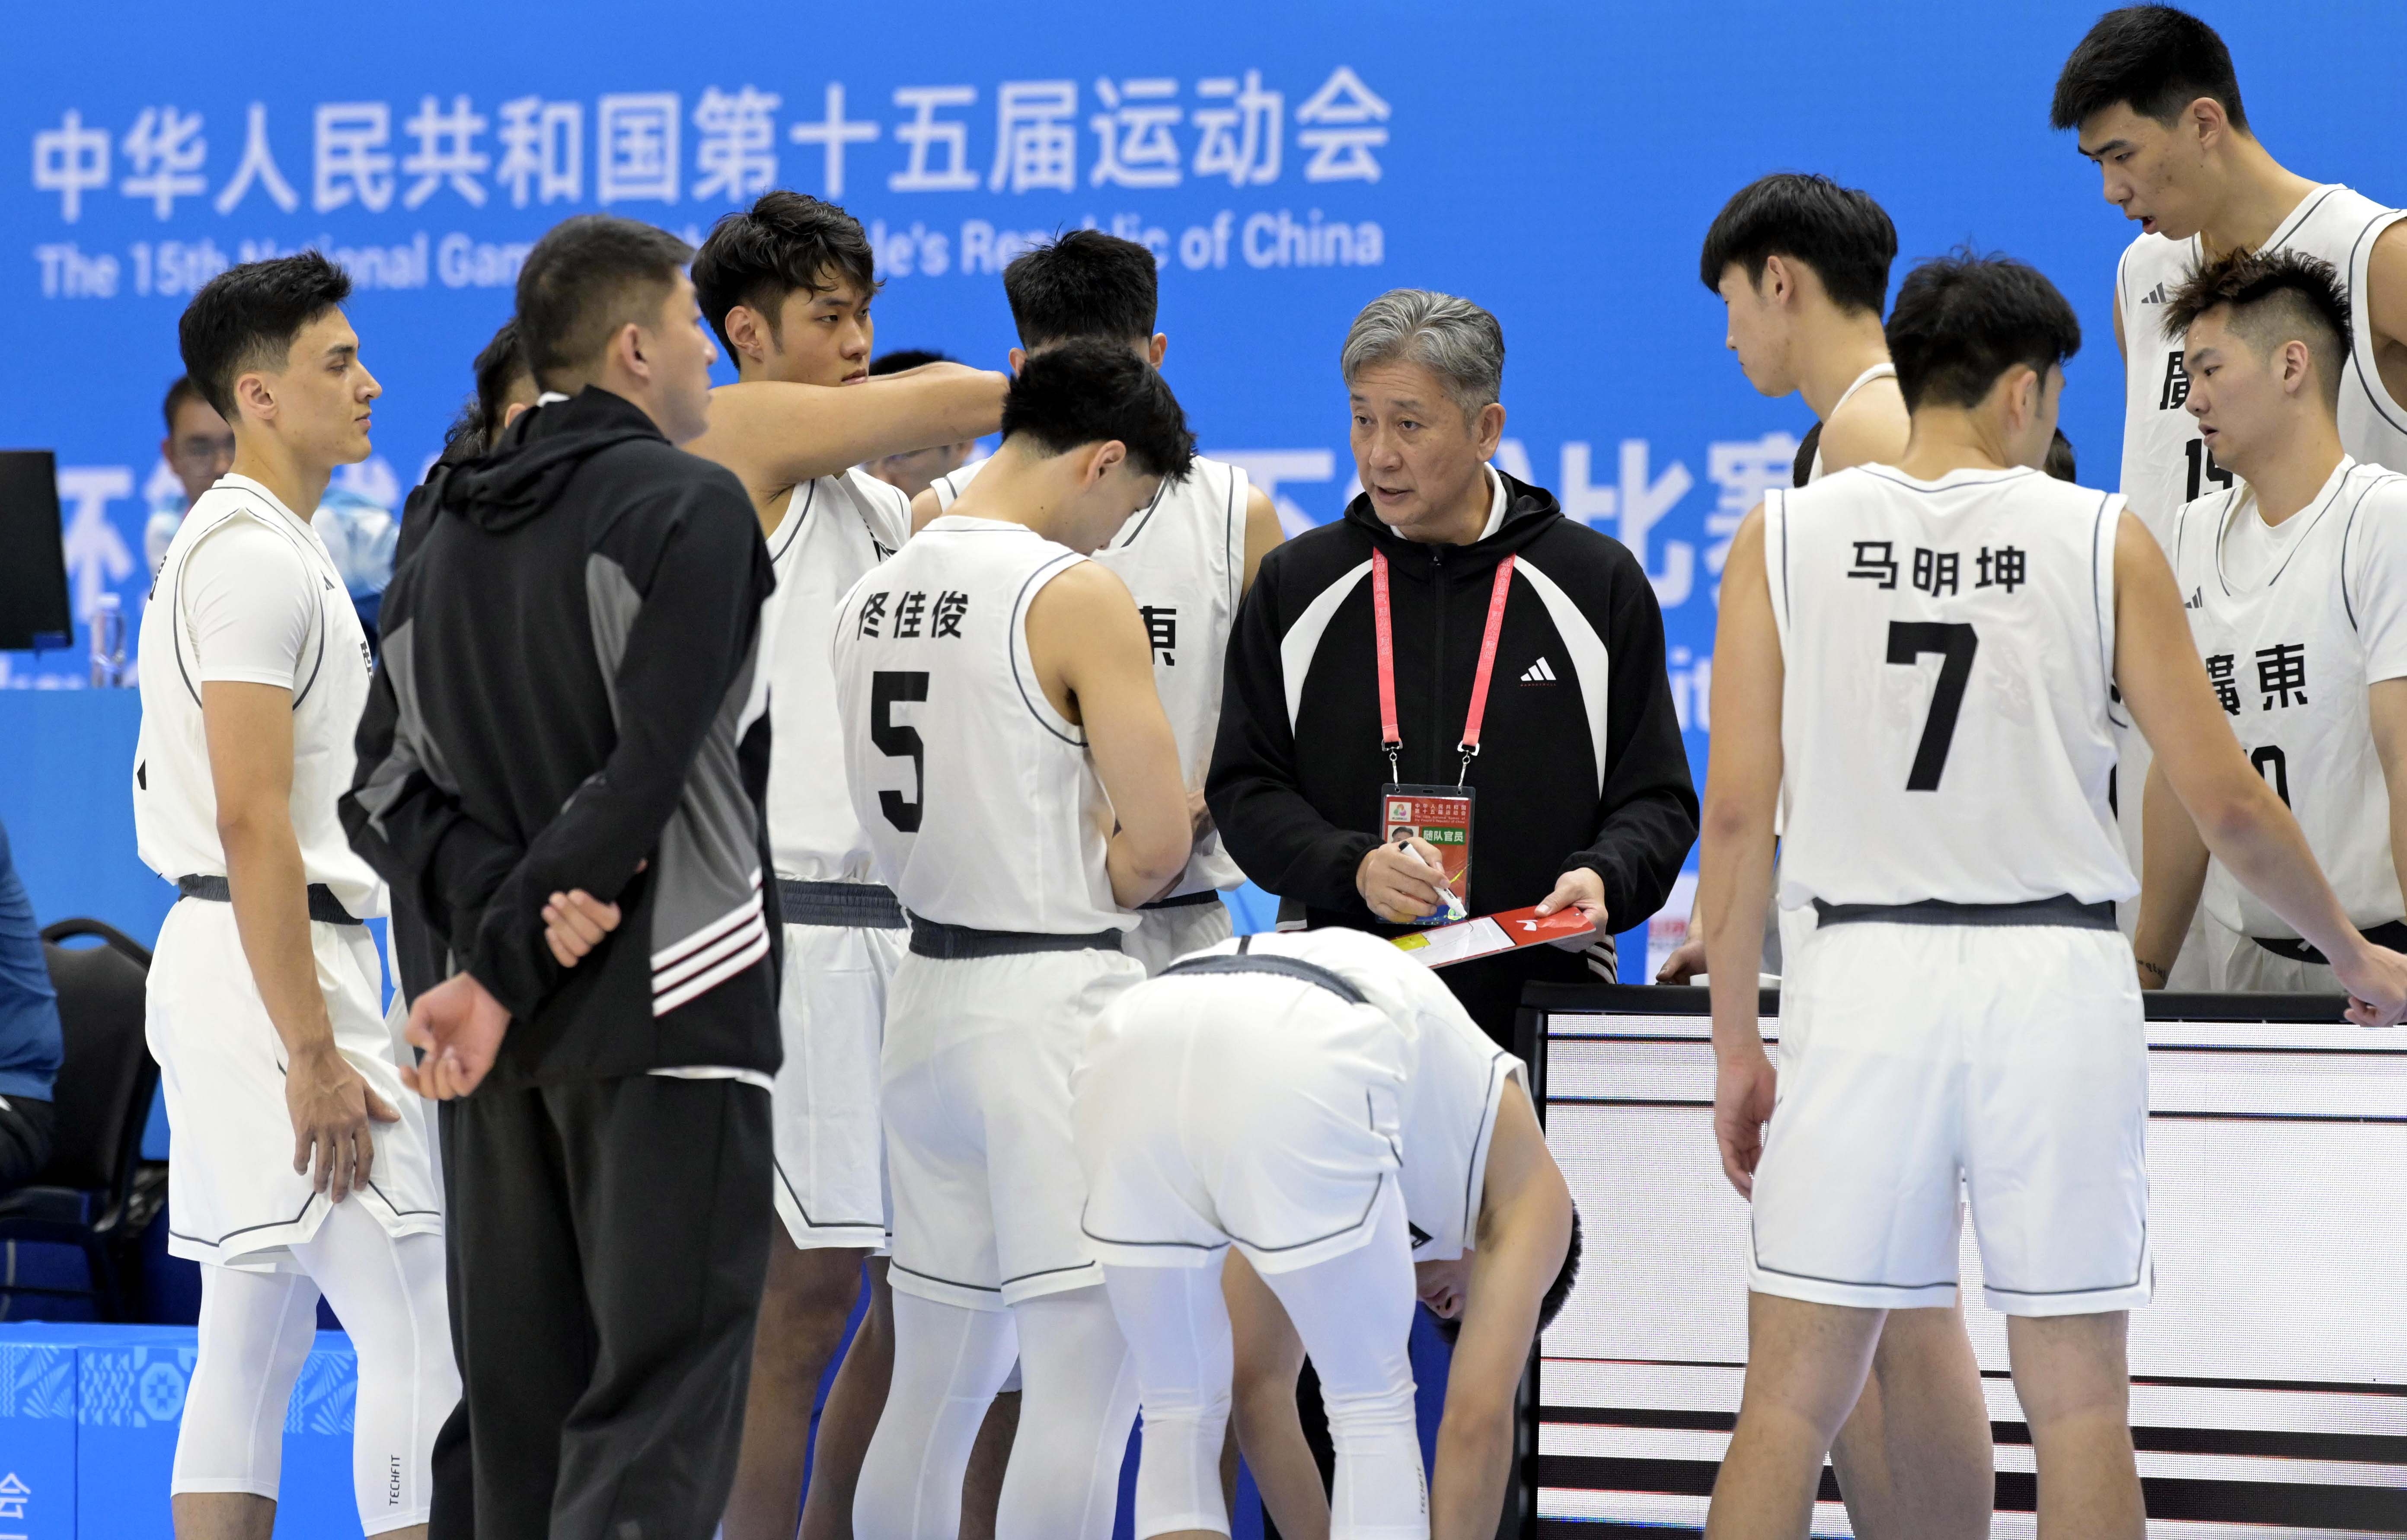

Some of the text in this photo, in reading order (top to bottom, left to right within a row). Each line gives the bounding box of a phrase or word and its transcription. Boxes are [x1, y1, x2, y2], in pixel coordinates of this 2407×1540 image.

[33, 66, 1392, 223] 中华人民共和国第十五届运动会
[35, 242, 119, 299] The
[1180, 210, 1236, 270] of
[1242, 208, 1384, 269] China
[1847, 541, 2027, 597] 马明坤
[856, 590, 969, 641] 佟佳俊
[1886, 621, 1979, 792] 7
[871, 671, 929, 833] 5
[1423, 829, 1464, 842] 随队官员
[389, 1454, 401, 1506] TECHFIT
